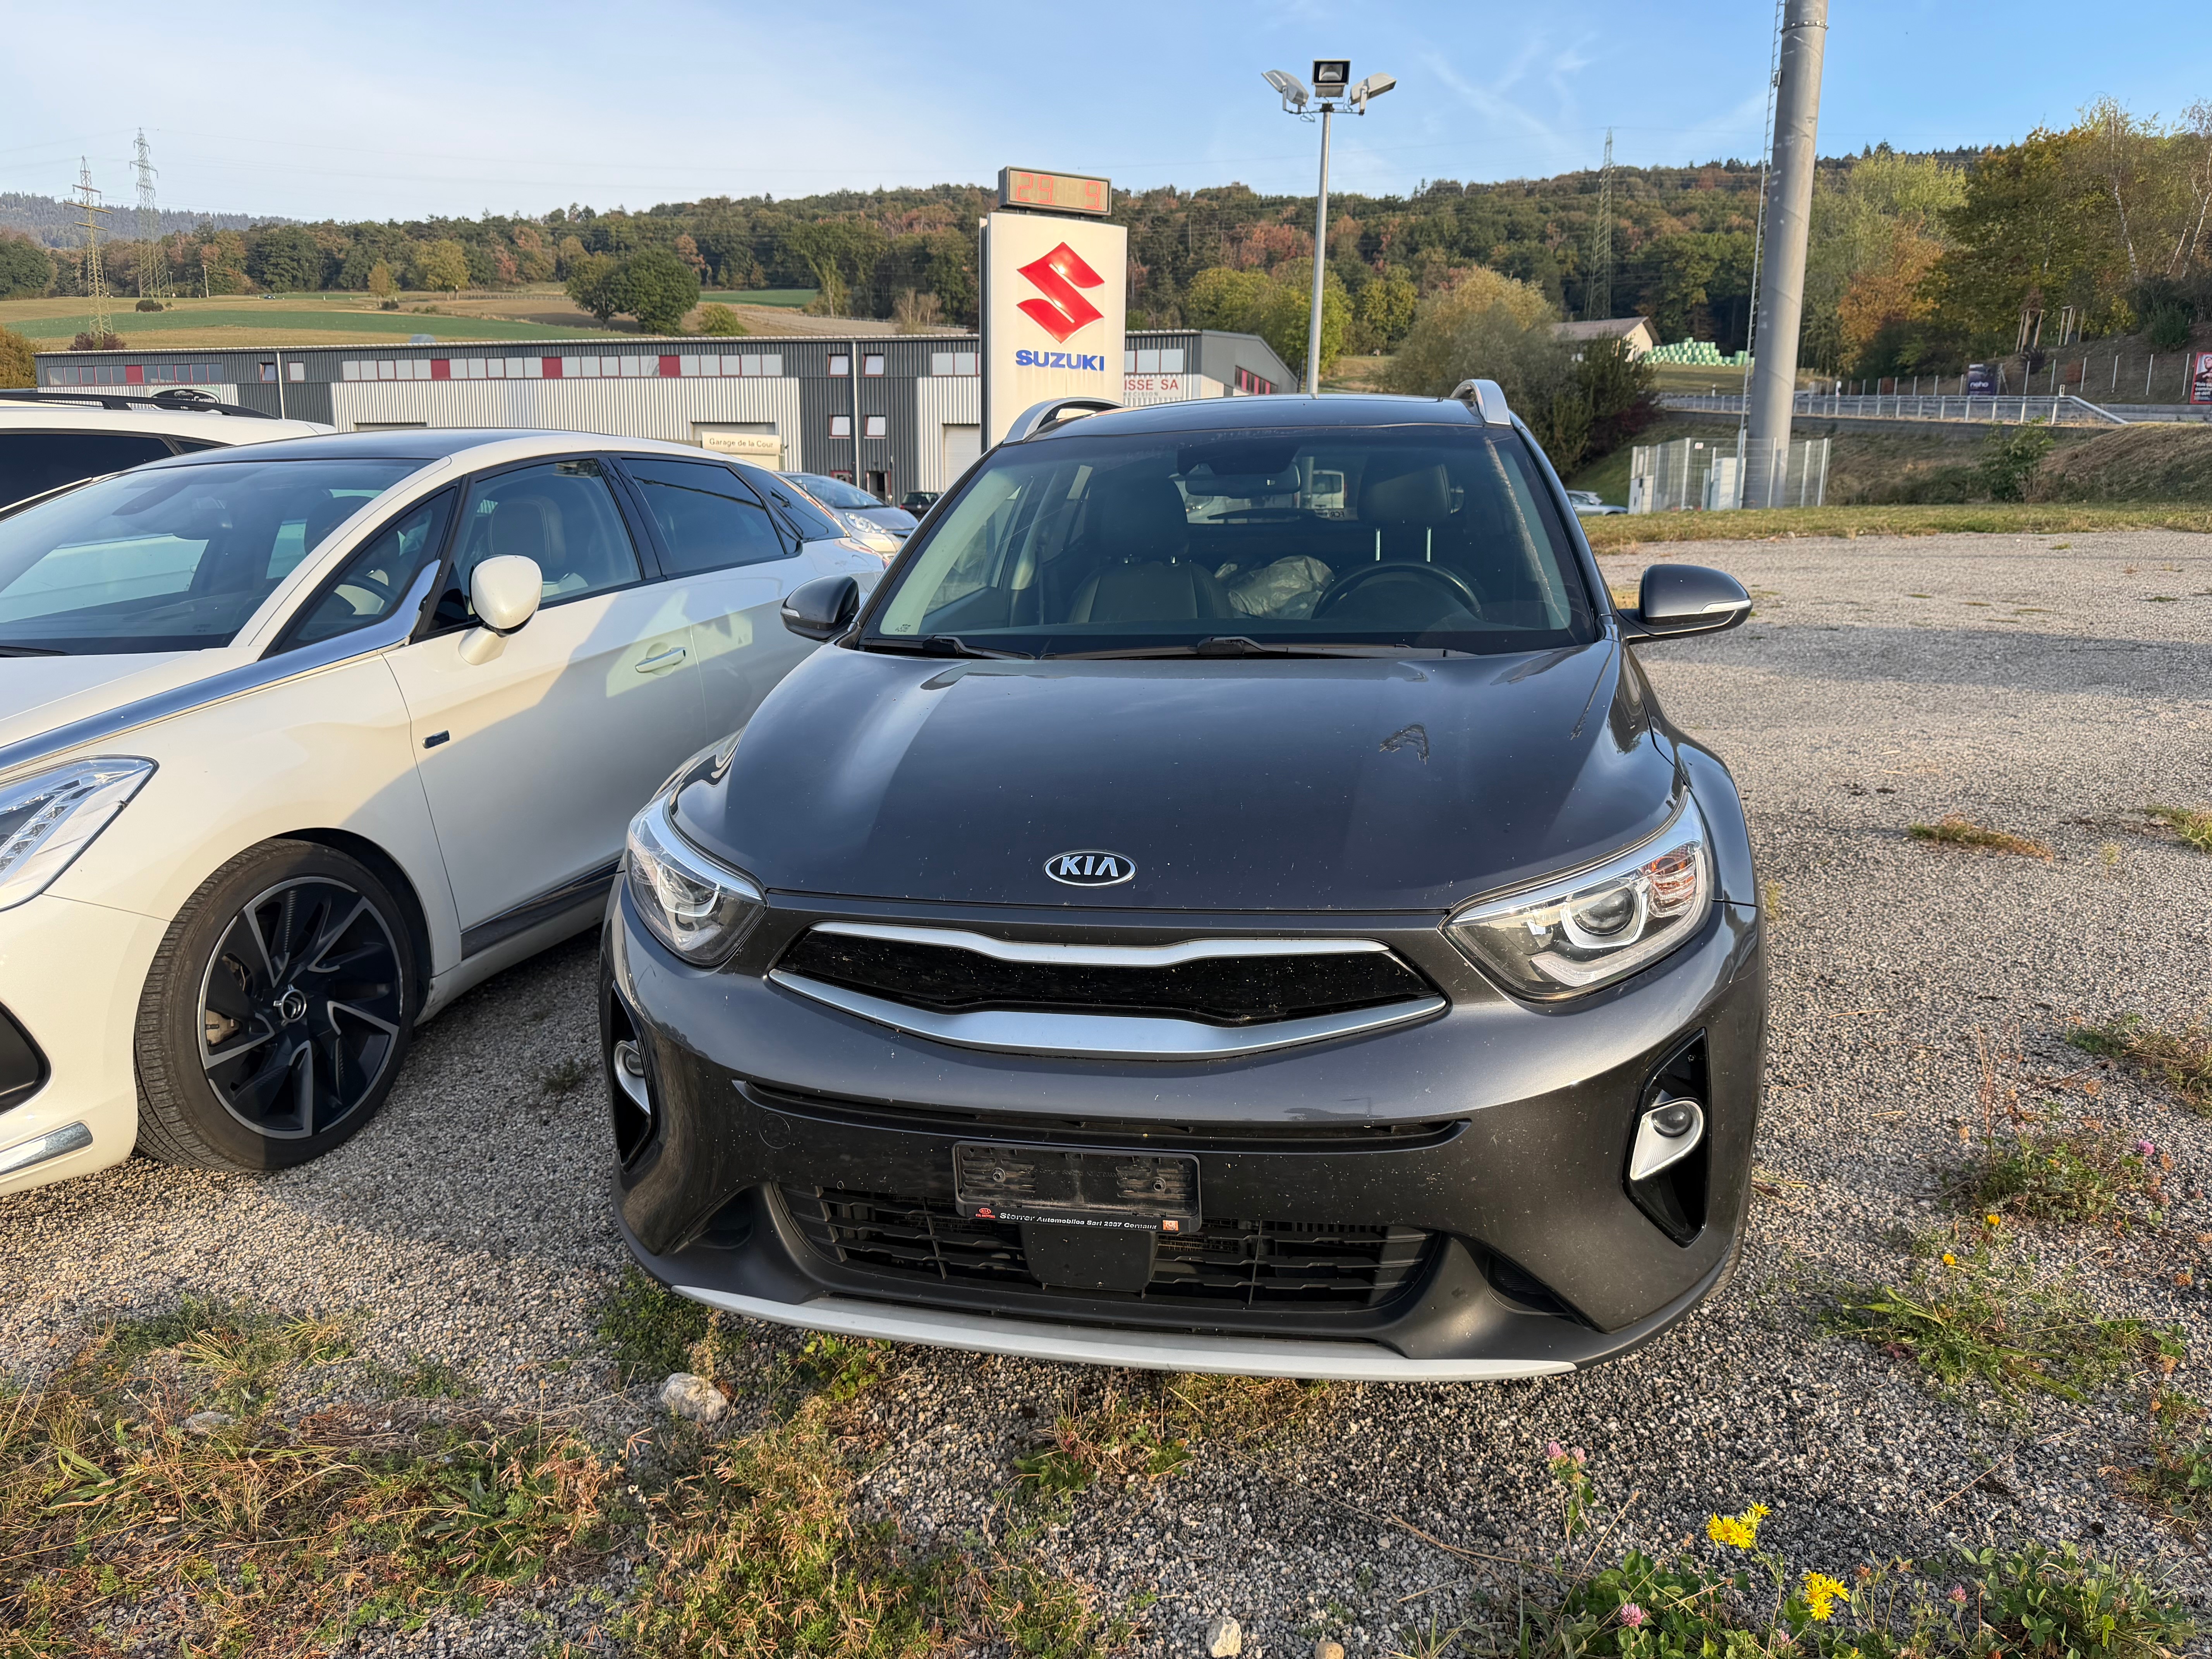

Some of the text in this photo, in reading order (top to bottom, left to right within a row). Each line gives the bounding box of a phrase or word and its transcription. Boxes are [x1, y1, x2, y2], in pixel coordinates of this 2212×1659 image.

[1016, 172, 1102, 210] 29 9
[1016, 349, 1104, 371] SUZUKI
[1161, 379, 1178, 390] SA
[709, 438, 735, 447] Garage
[1060, 856, 1118, 877] KIA
